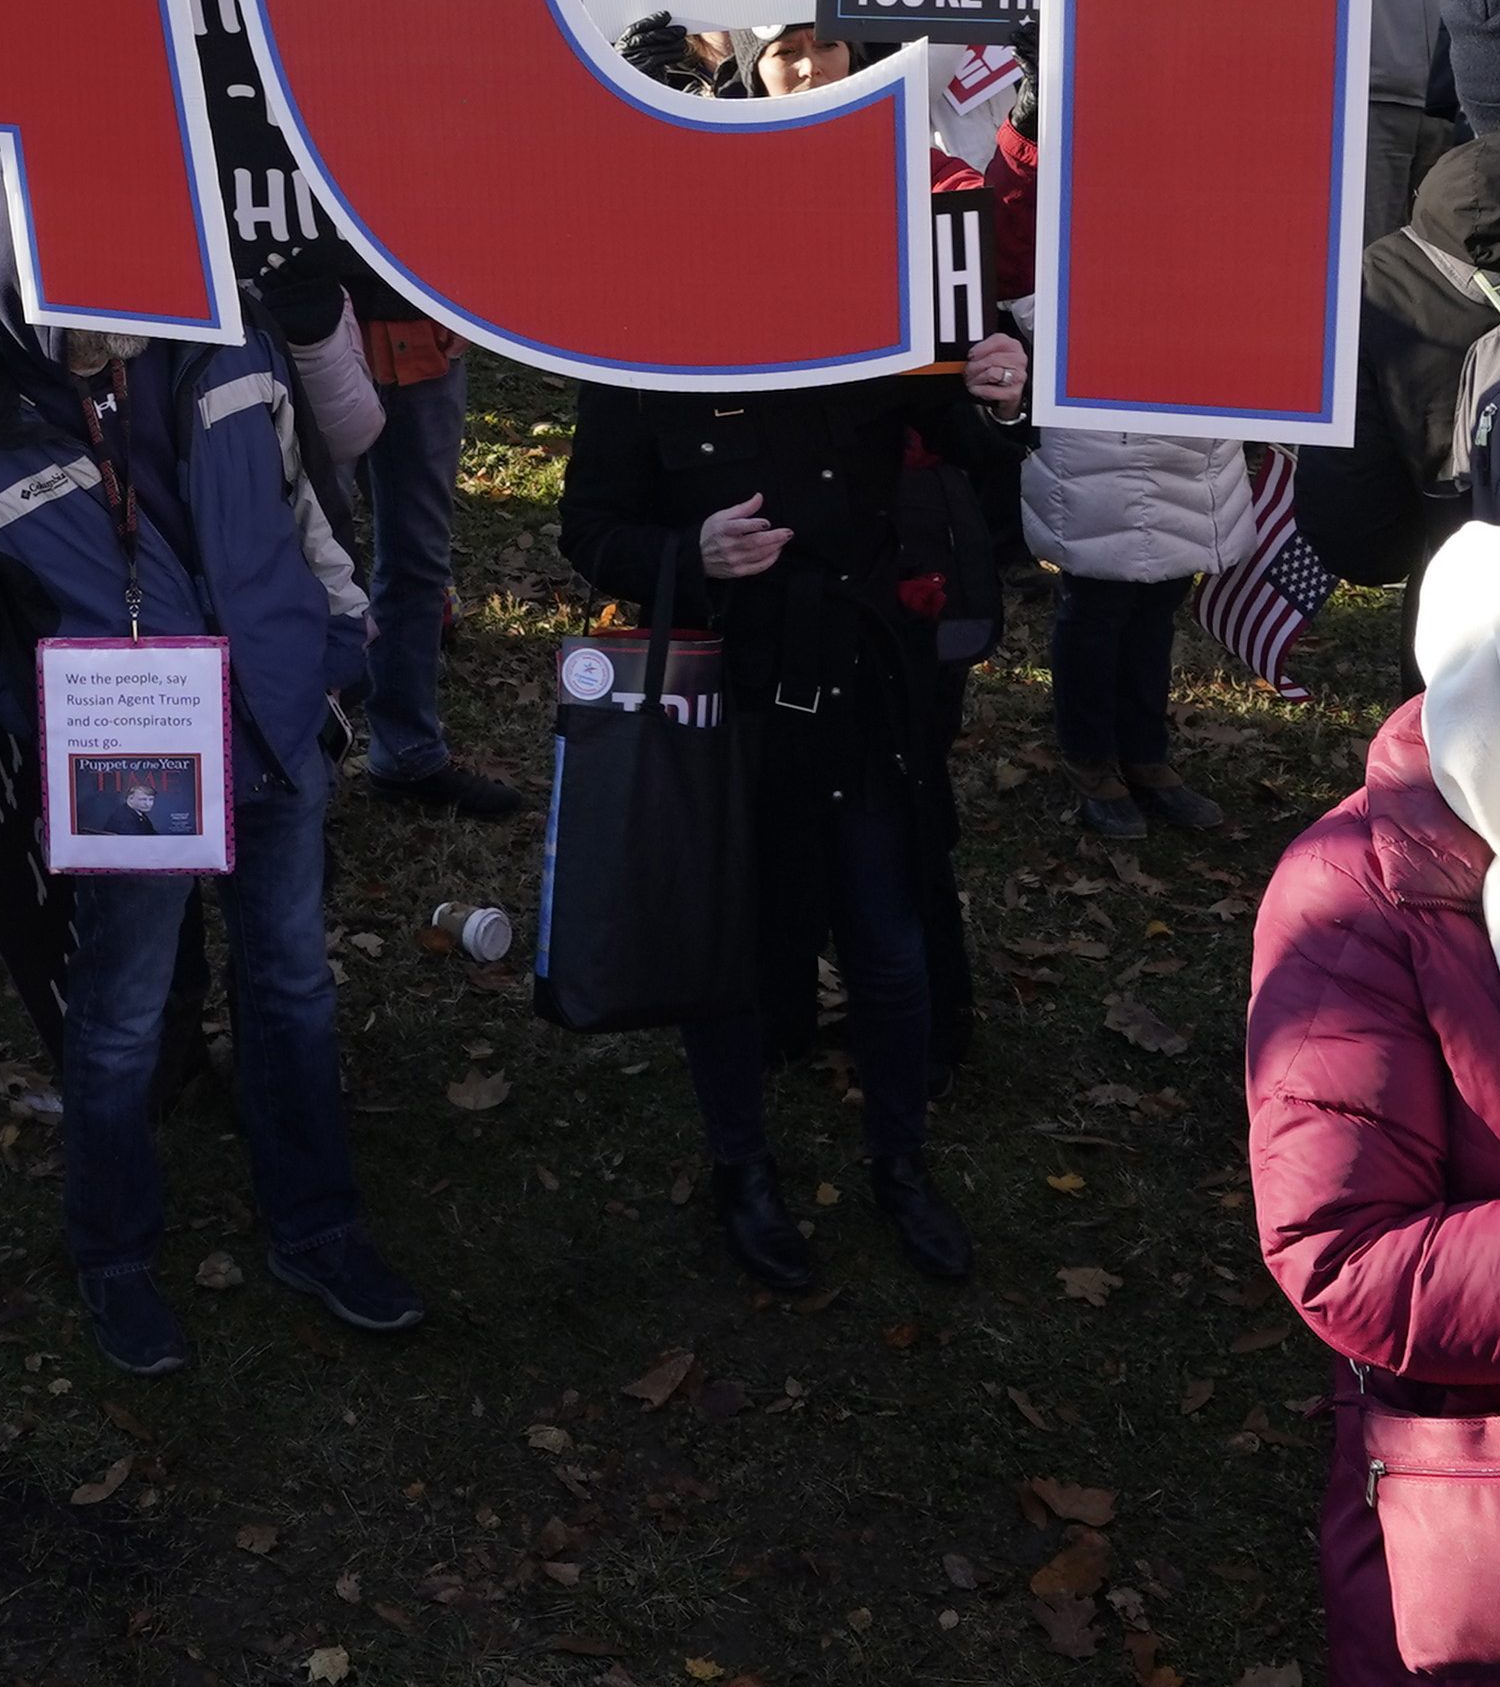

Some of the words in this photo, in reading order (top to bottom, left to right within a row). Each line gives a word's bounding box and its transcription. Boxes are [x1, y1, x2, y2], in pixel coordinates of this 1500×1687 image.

[65, 673, 87, 685] We
[91, 673, 111, 685] the
[115, 673, 162, 686] people,
[166, 675, 187, 686] say
[66, 694, 114, 705] Russian
[118, 694, 155, 707] Agent
[159, 695, 200, 707] Trump
[67, 716, 90, 727] and
[94, 716, 192, 728] co-conspirators
[67, 737, 99, 748] must
[103, 738, 122, 750] go.
[79, 759, 127, 771] Puppet
[130, 760, 142, 771] of
[158, 759, 190, 770] Year
